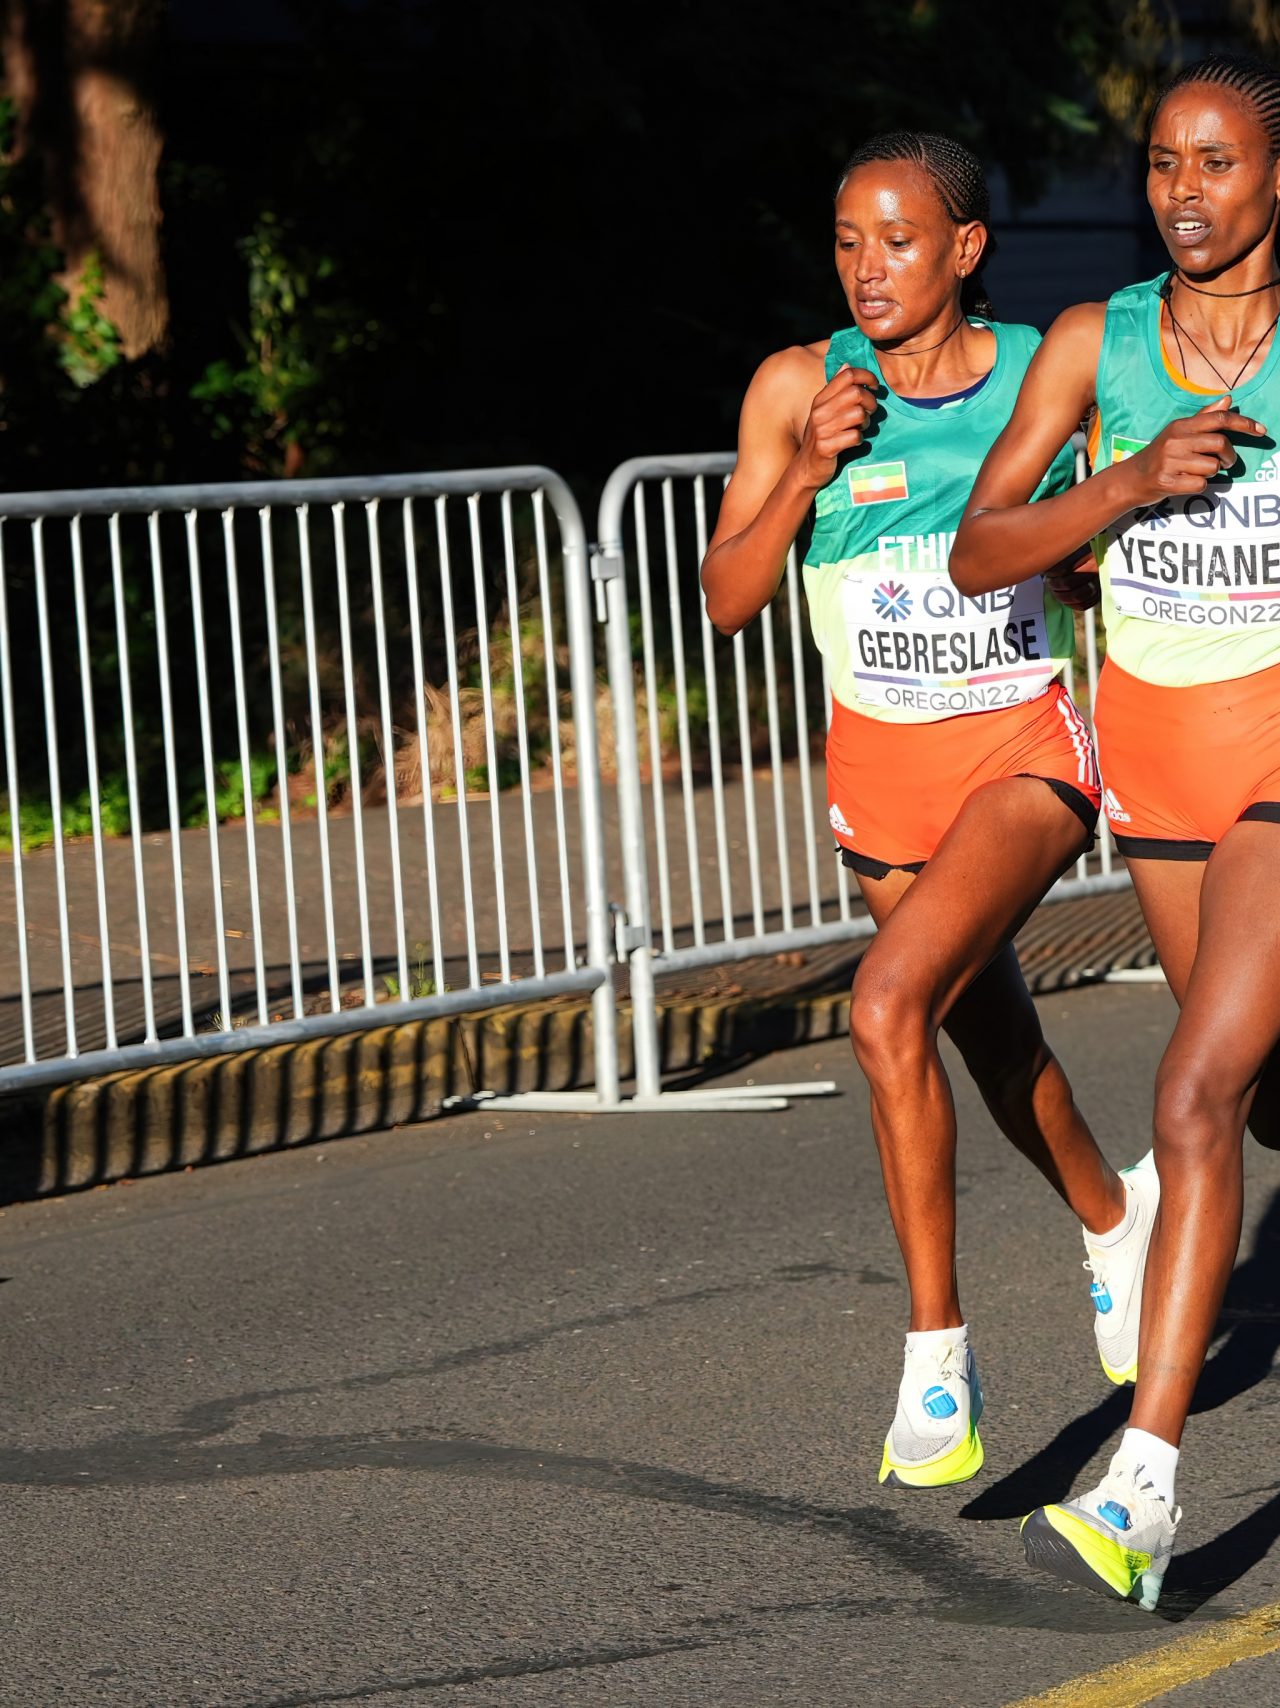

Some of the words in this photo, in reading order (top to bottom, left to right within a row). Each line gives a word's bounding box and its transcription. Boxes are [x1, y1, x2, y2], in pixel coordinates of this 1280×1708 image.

[878, 532, 957, 574] ETHI
[923, 585, 1015, 618] QNB
[858, 619, 1041, 675] GEBRESLASE
[884, 684, 1020, 712] OREGON22
